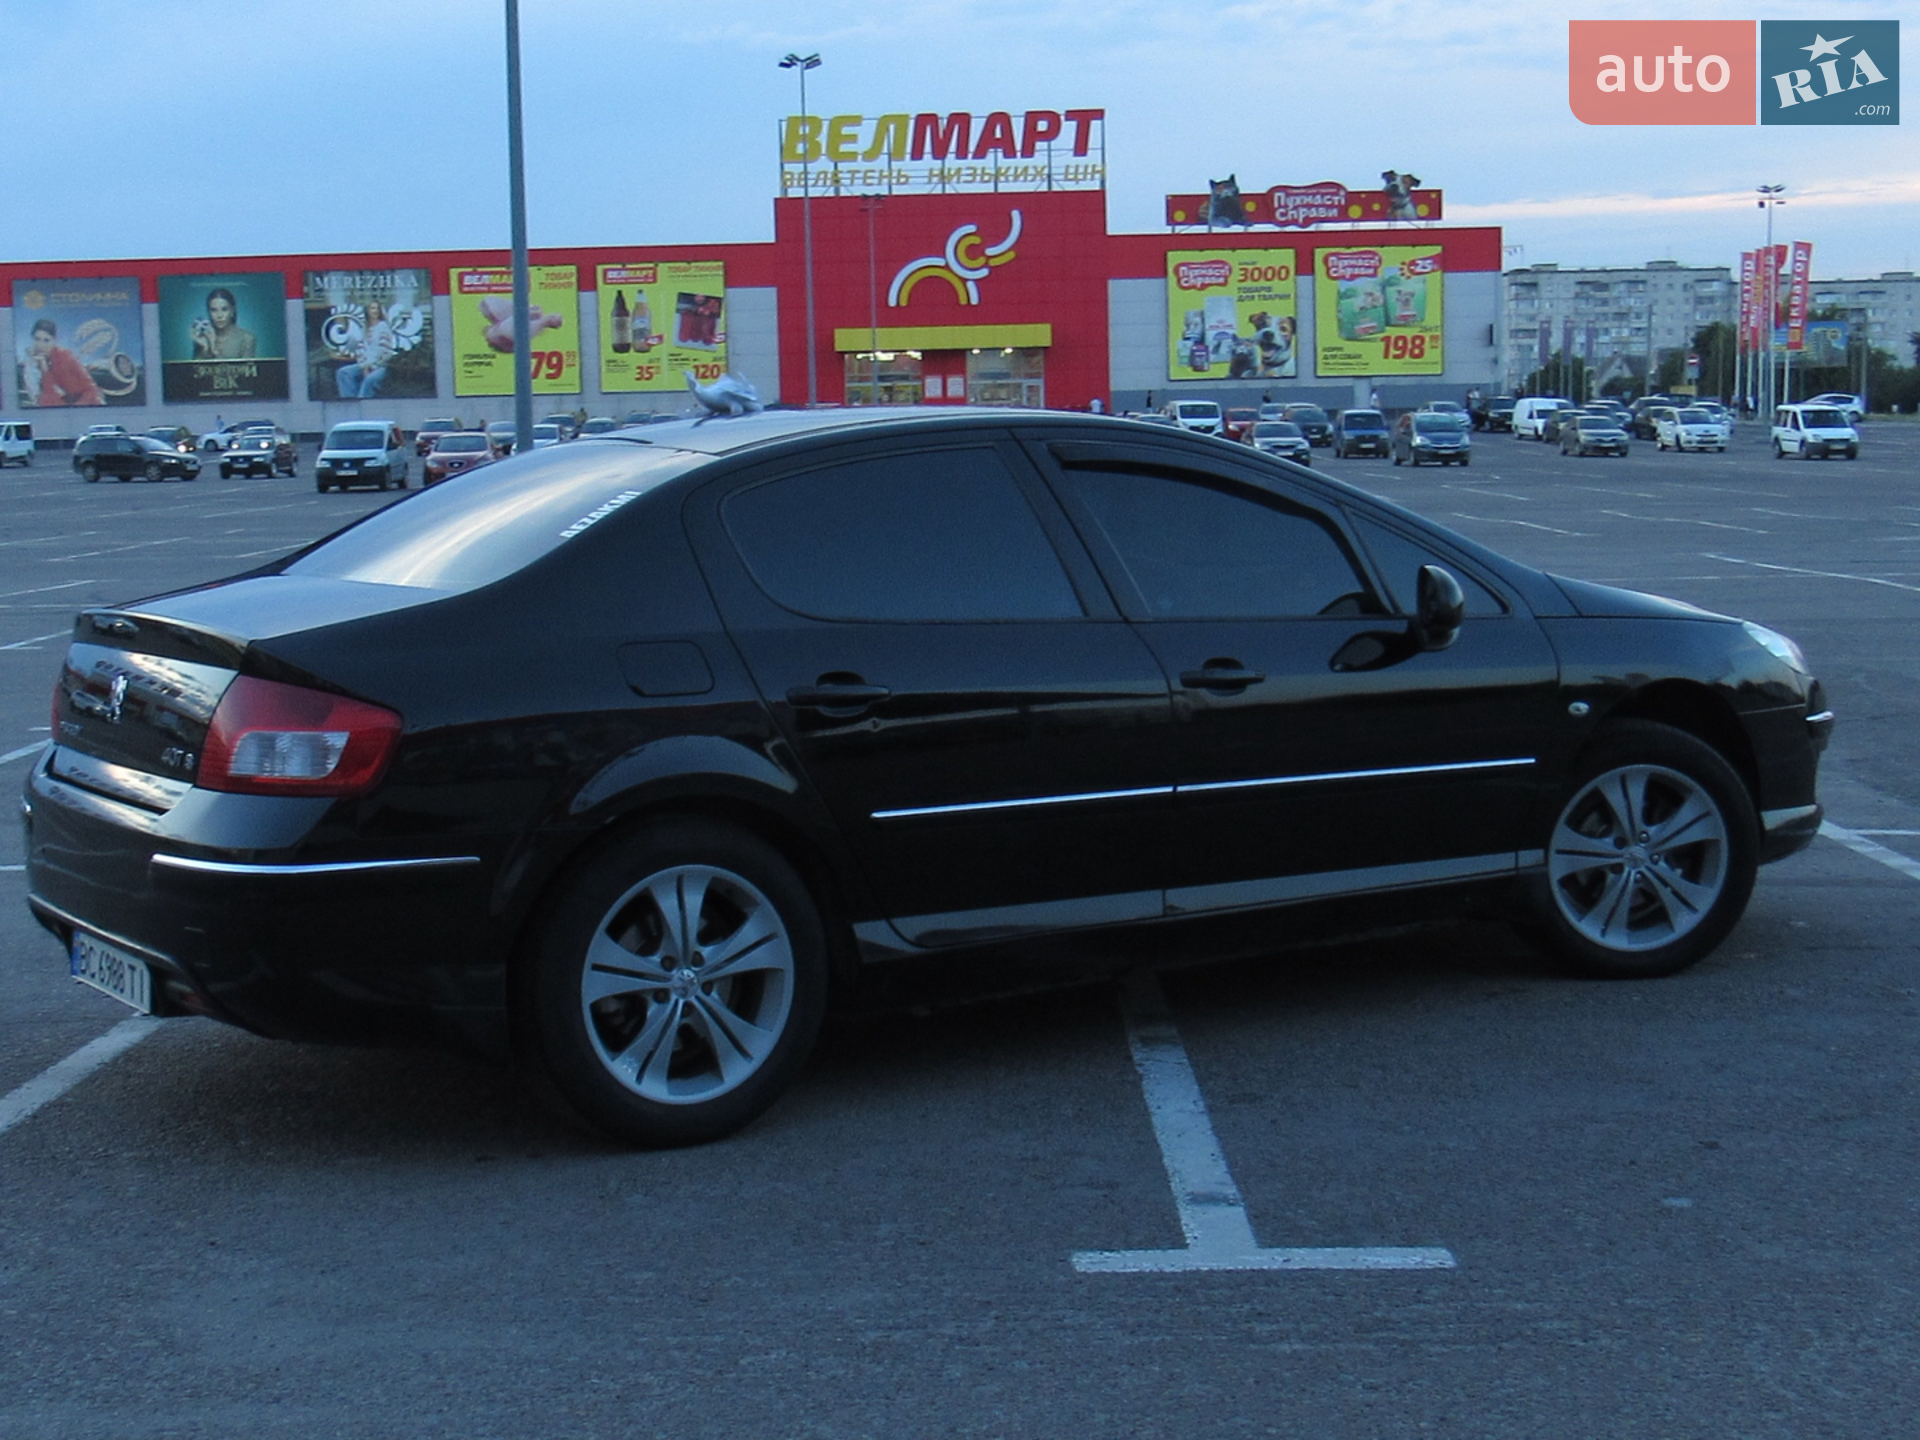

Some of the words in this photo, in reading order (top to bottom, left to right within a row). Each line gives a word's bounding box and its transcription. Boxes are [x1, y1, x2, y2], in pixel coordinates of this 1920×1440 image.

[783, 109, 1105, 163] ВЕЛМАРТ
[1237, 265, 1290, 283] 3000
[1380, 334, 1426, 360] 198
[530, 350, 564, 380] 79
[634, 365, 654, 381] 35
[692, 363, 720, 380] 120
